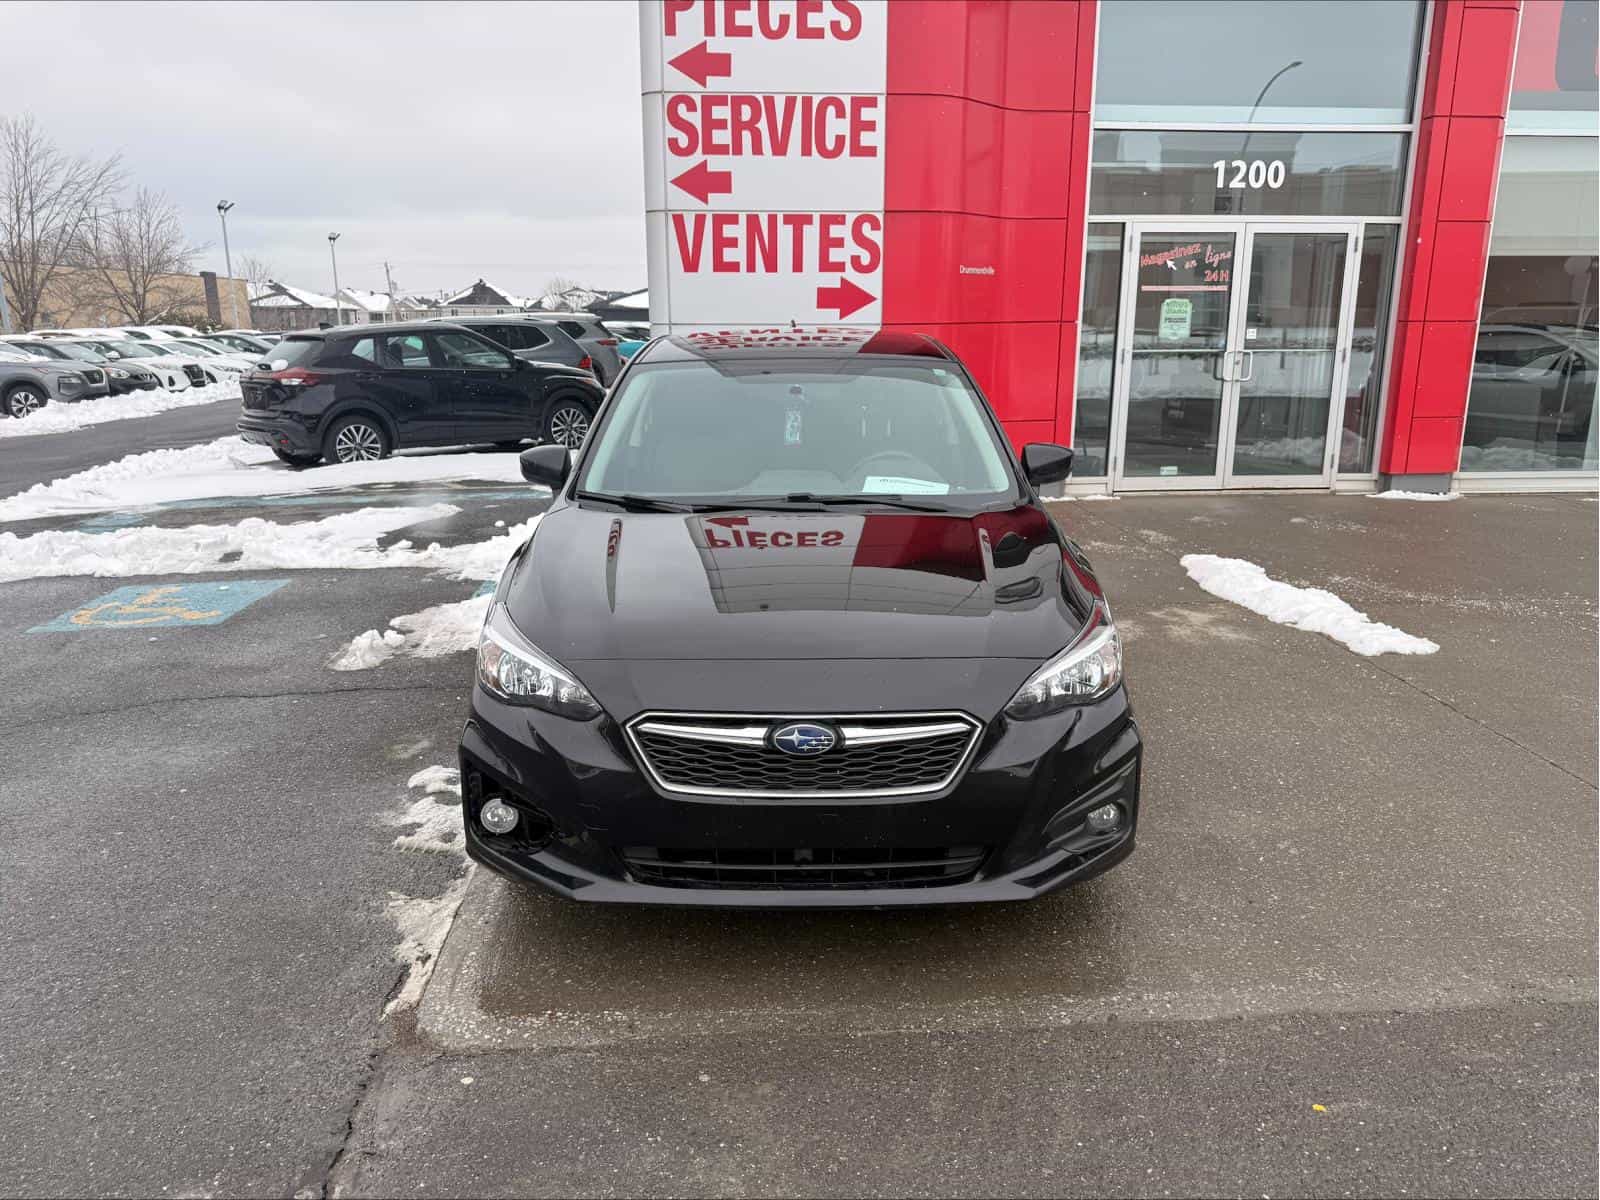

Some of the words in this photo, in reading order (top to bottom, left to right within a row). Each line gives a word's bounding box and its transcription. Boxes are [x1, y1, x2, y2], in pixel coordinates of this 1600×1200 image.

[666, 94, 878, 159] SERVICE
[1213, 159, 1286, 189] 1200
[672, 213, 881, 274] VENTES
[1205, 244, 1232, 267] ligne
